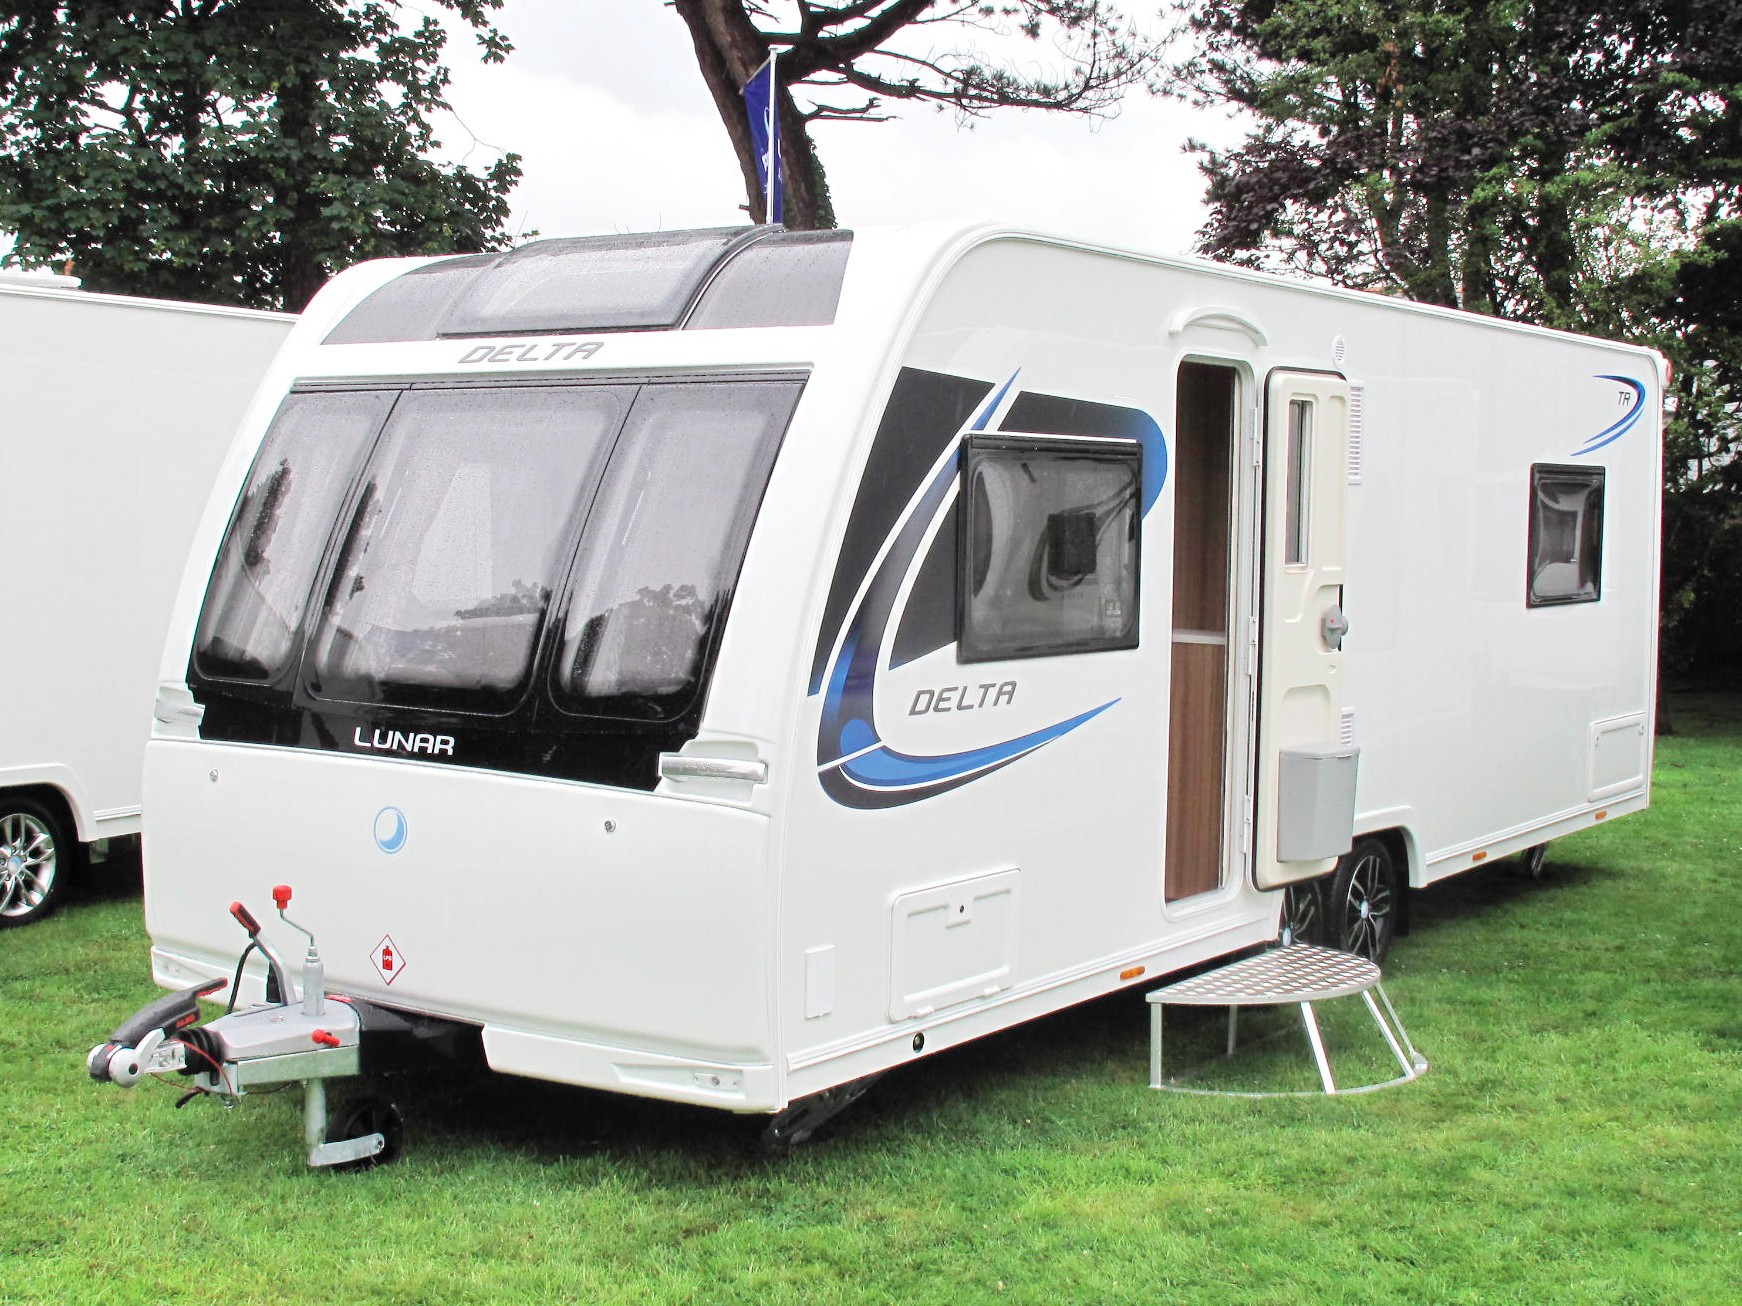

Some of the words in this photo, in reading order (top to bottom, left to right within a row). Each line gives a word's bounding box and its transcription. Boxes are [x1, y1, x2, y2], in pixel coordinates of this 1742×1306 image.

[458, 342, 604, 363] DELTA
[1617, 391, 1631, 406] TR
[908, 681, 1017, 715] DELTA
[354, 726, 455, 755] LUNAR
